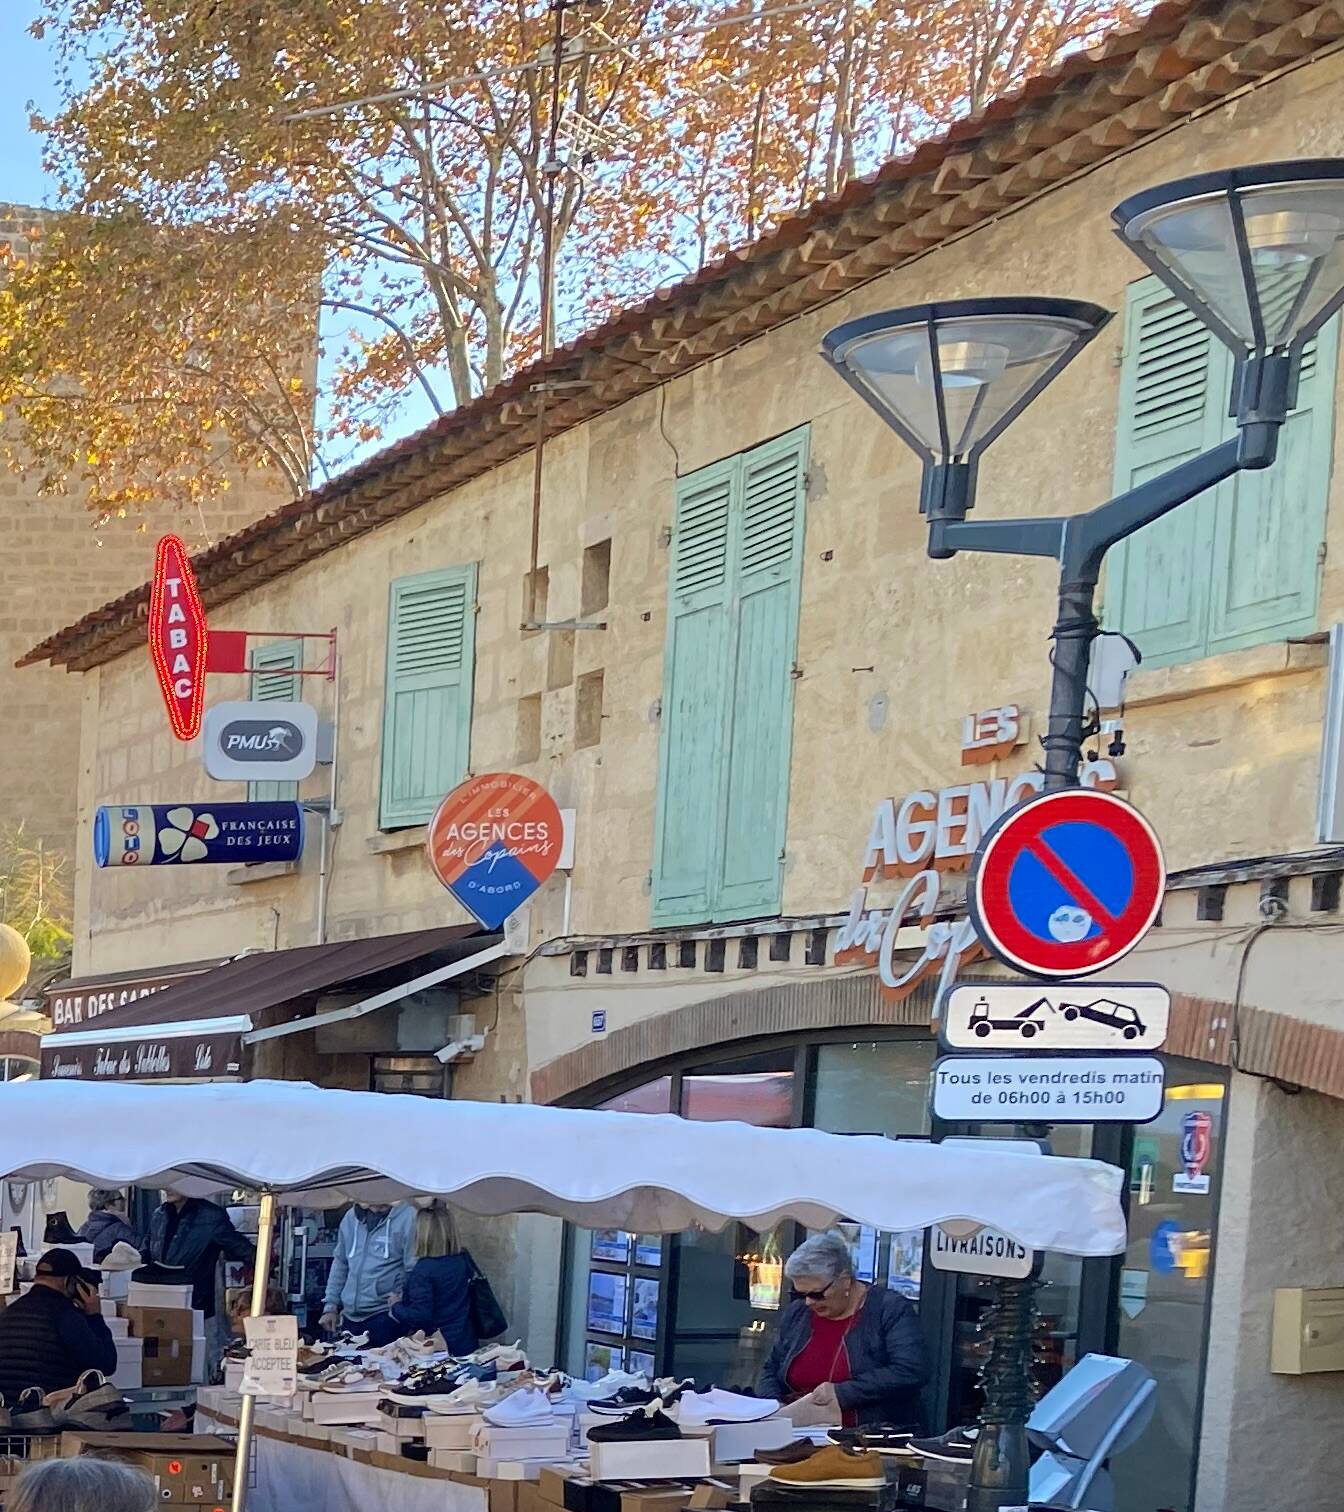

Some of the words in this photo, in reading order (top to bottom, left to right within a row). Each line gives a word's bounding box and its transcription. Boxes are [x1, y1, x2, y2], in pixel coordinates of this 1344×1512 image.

[165, 577, 193, 699] TABAC
[961, 704, 1020, 751] LES
[226, 734, 268, 750] PMU
[487, 808, 510, 818] LES
[221, 819, 297, 833] FRANÇAISE
[446, 822, 549, 841] AGENCES
[226, 836, 252, 847] DES
[257, 835, 291, 847] JEUX
[442, 841, 465, 858] des
[463, 838, 554, 874] Copains
[467, 880, 521, 894] D'ABORD
[54, 995, 84, 1025] BAR
[938, 1071, 982, 1085] Tous
[987, 1071, 1012, 1085] les
[1018, 1070, 1107, 1085] vendredis
[1112, 1070, 1163, 1084] matin
[971, 1091, 993, 1105] de
[998, 1091, 1051, 1105] 06h00
[1056, 1091, 1066, 1105] à
[1073, 1091, 1126, 1105] 15h00
[936, 1231, 1026, 1259] LIVRAISONS
